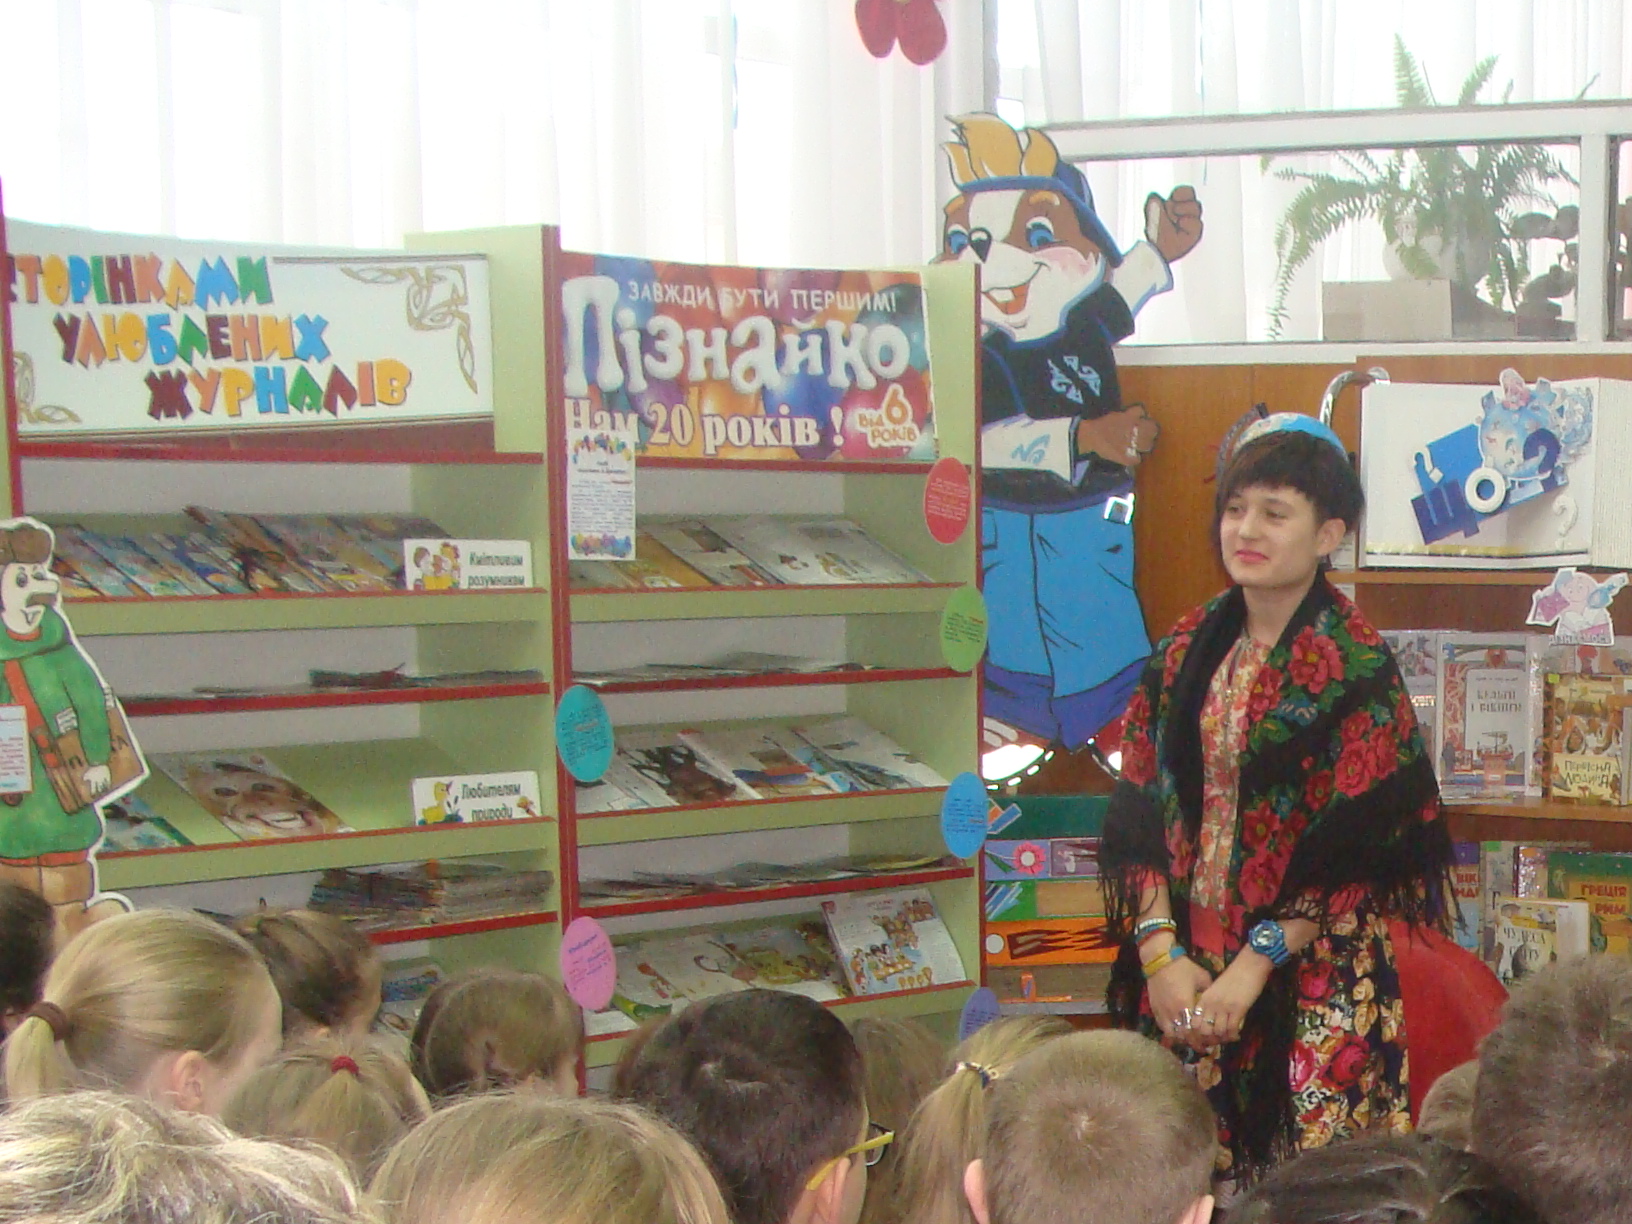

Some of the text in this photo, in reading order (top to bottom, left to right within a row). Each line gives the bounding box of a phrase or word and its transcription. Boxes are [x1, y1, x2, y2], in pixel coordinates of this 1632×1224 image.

[628, 281, 897, 312] ЗАВЖДИ БУТИ ПЕРШИМ!
[53, 313, 331, 369] УЛЮБЛЕНИХ
[144, 359, 412, 420] ЖУРНАЛІВ
[649, 402, 694, 446] 20
[701, 403, 821, 456] років
[461, 782, 520, 800] Любителям
